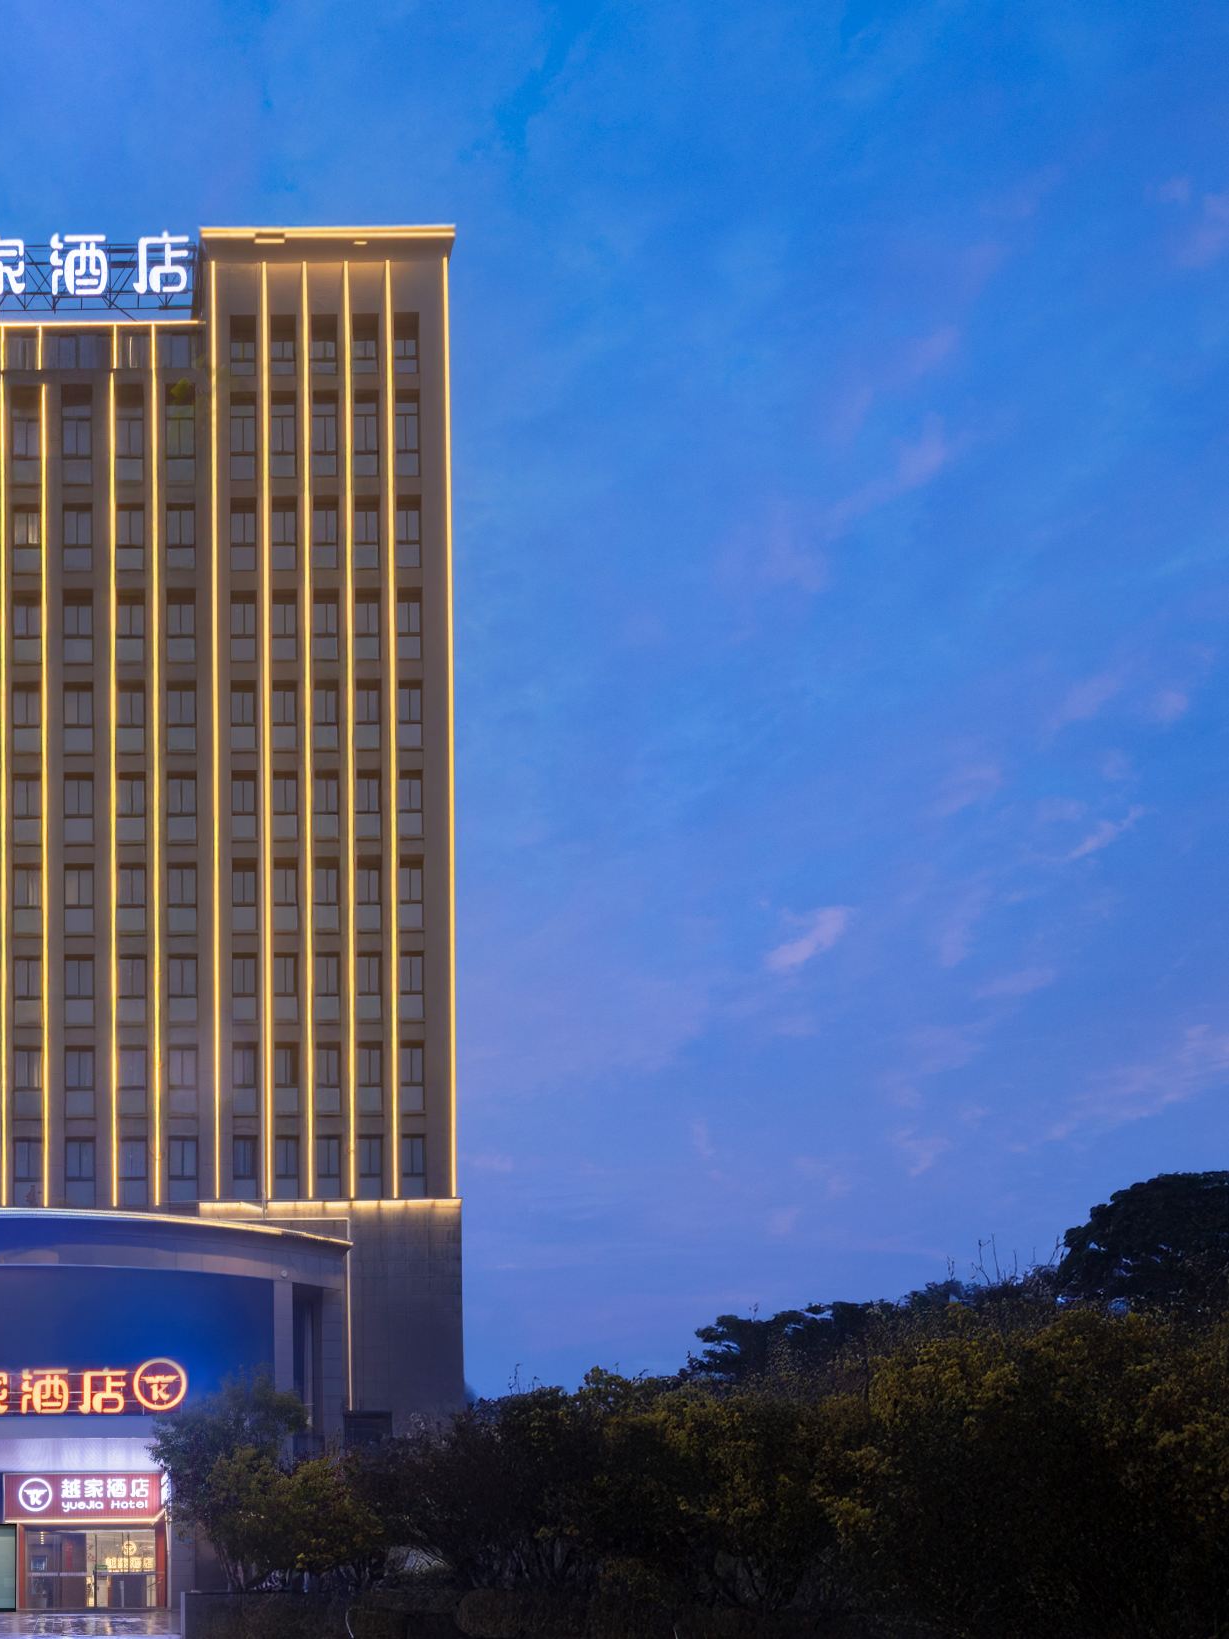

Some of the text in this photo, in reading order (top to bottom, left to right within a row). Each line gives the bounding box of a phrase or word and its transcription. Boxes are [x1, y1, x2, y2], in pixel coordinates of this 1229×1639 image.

[61, 1478, 149, 1498] 越家酒店
[110, 1499, 148, 1509] Hotel
